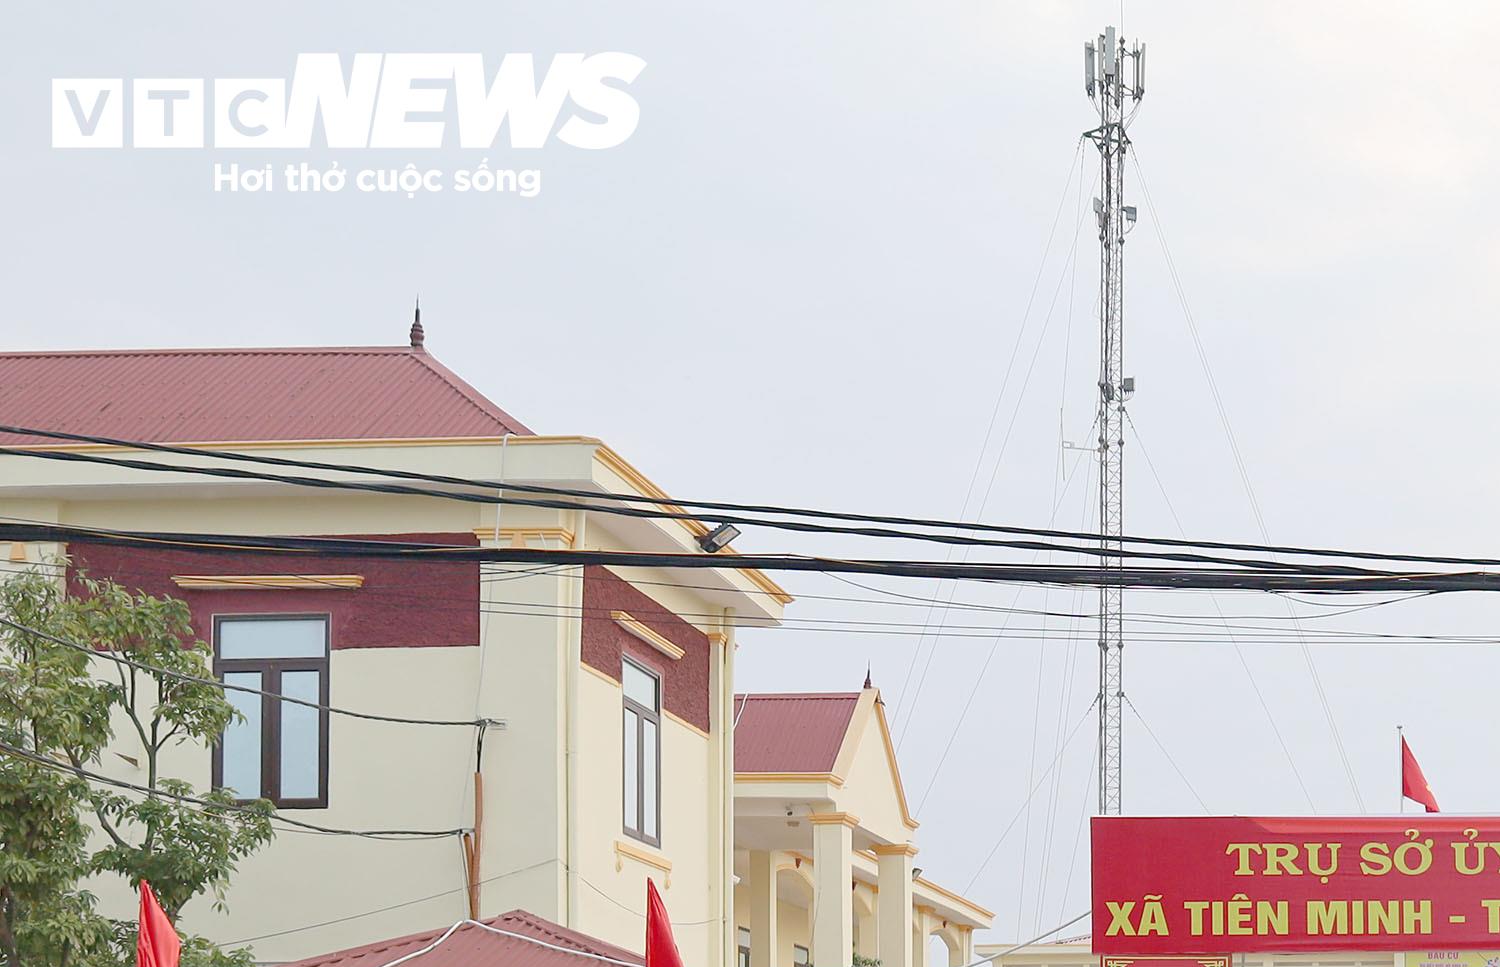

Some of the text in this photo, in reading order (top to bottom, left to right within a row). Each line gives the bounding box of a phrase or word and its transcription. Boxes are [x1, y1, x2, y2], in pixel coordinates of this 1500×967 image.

[1226, 844, 1341, 883] TRỤ
[1360, 829, 1433, 875] SỞ
[1106, 895, 1168, 935] XÃ
[1184, 894, 1288, 935] TIÊN
[1307, 901, 1431, 934] MINH
